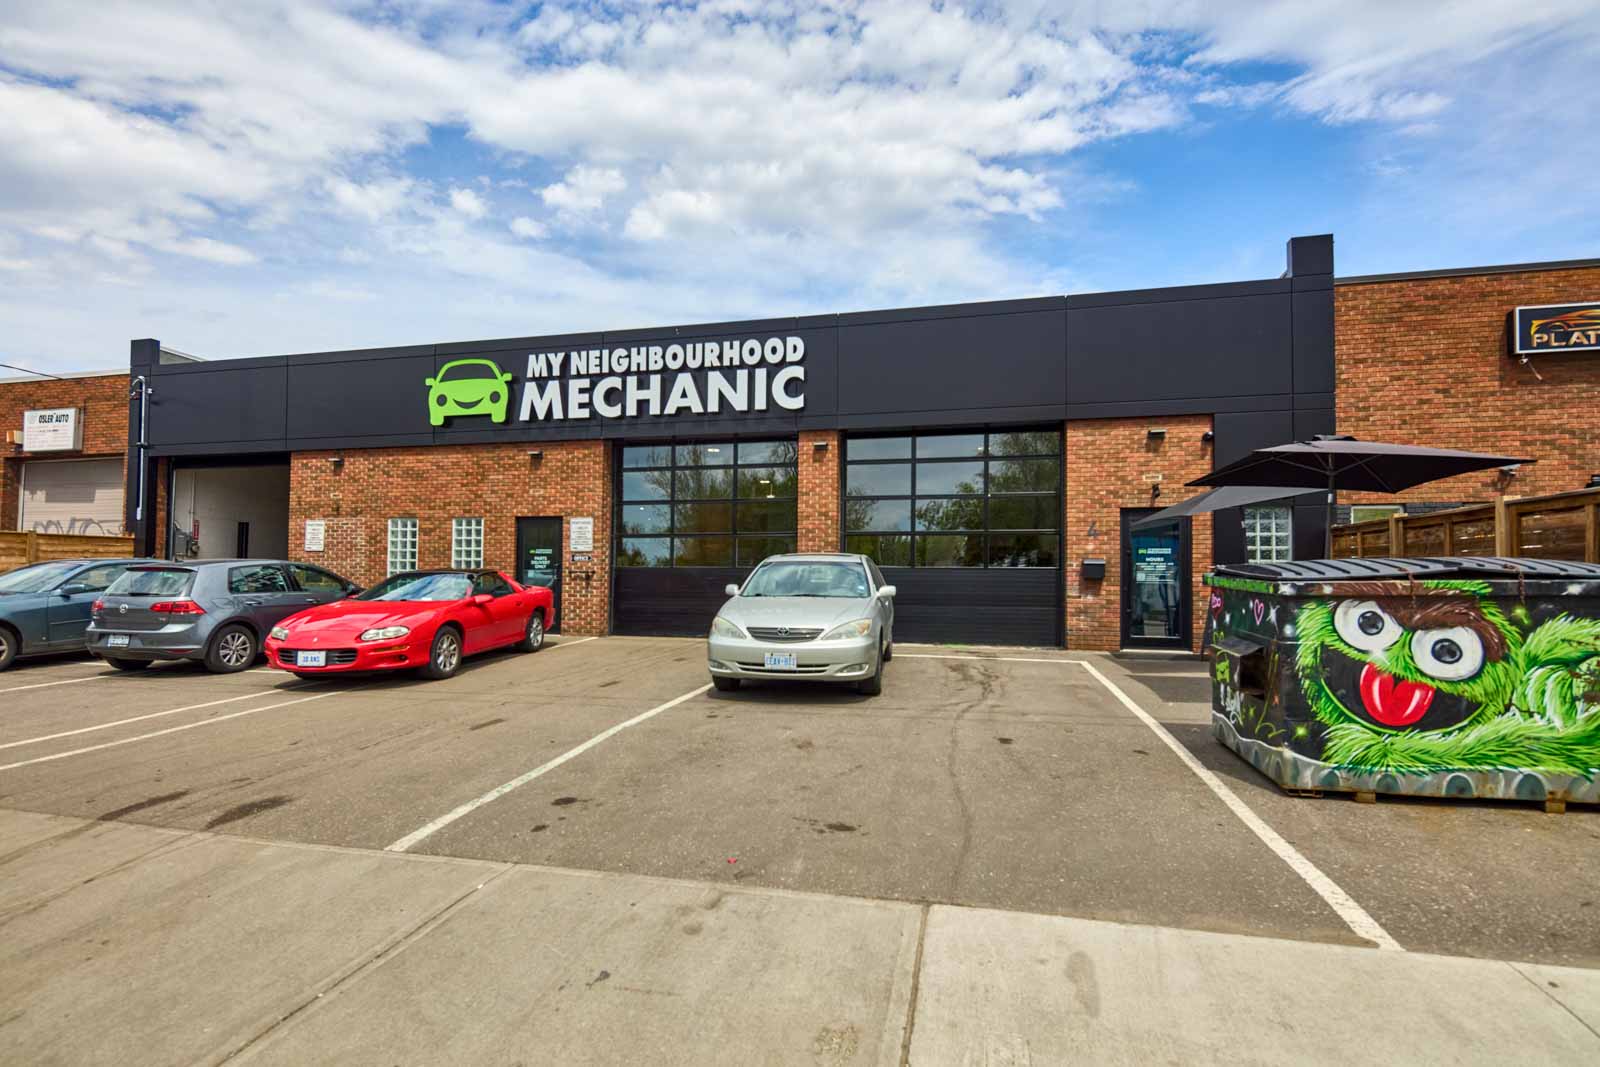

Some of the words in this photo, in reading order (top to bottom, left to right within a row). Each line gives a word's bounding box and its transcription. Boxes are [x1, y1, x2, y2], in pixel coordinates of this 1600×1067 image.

[526, 352, 565, 378] MY
[570, 336, 805, 376] NEIGHBOURHOOD
[519, 365, 805, 421] MECHANIC
[38, 414, 54, 423] OSLER
[55, 414, 69, 423] AUTO
